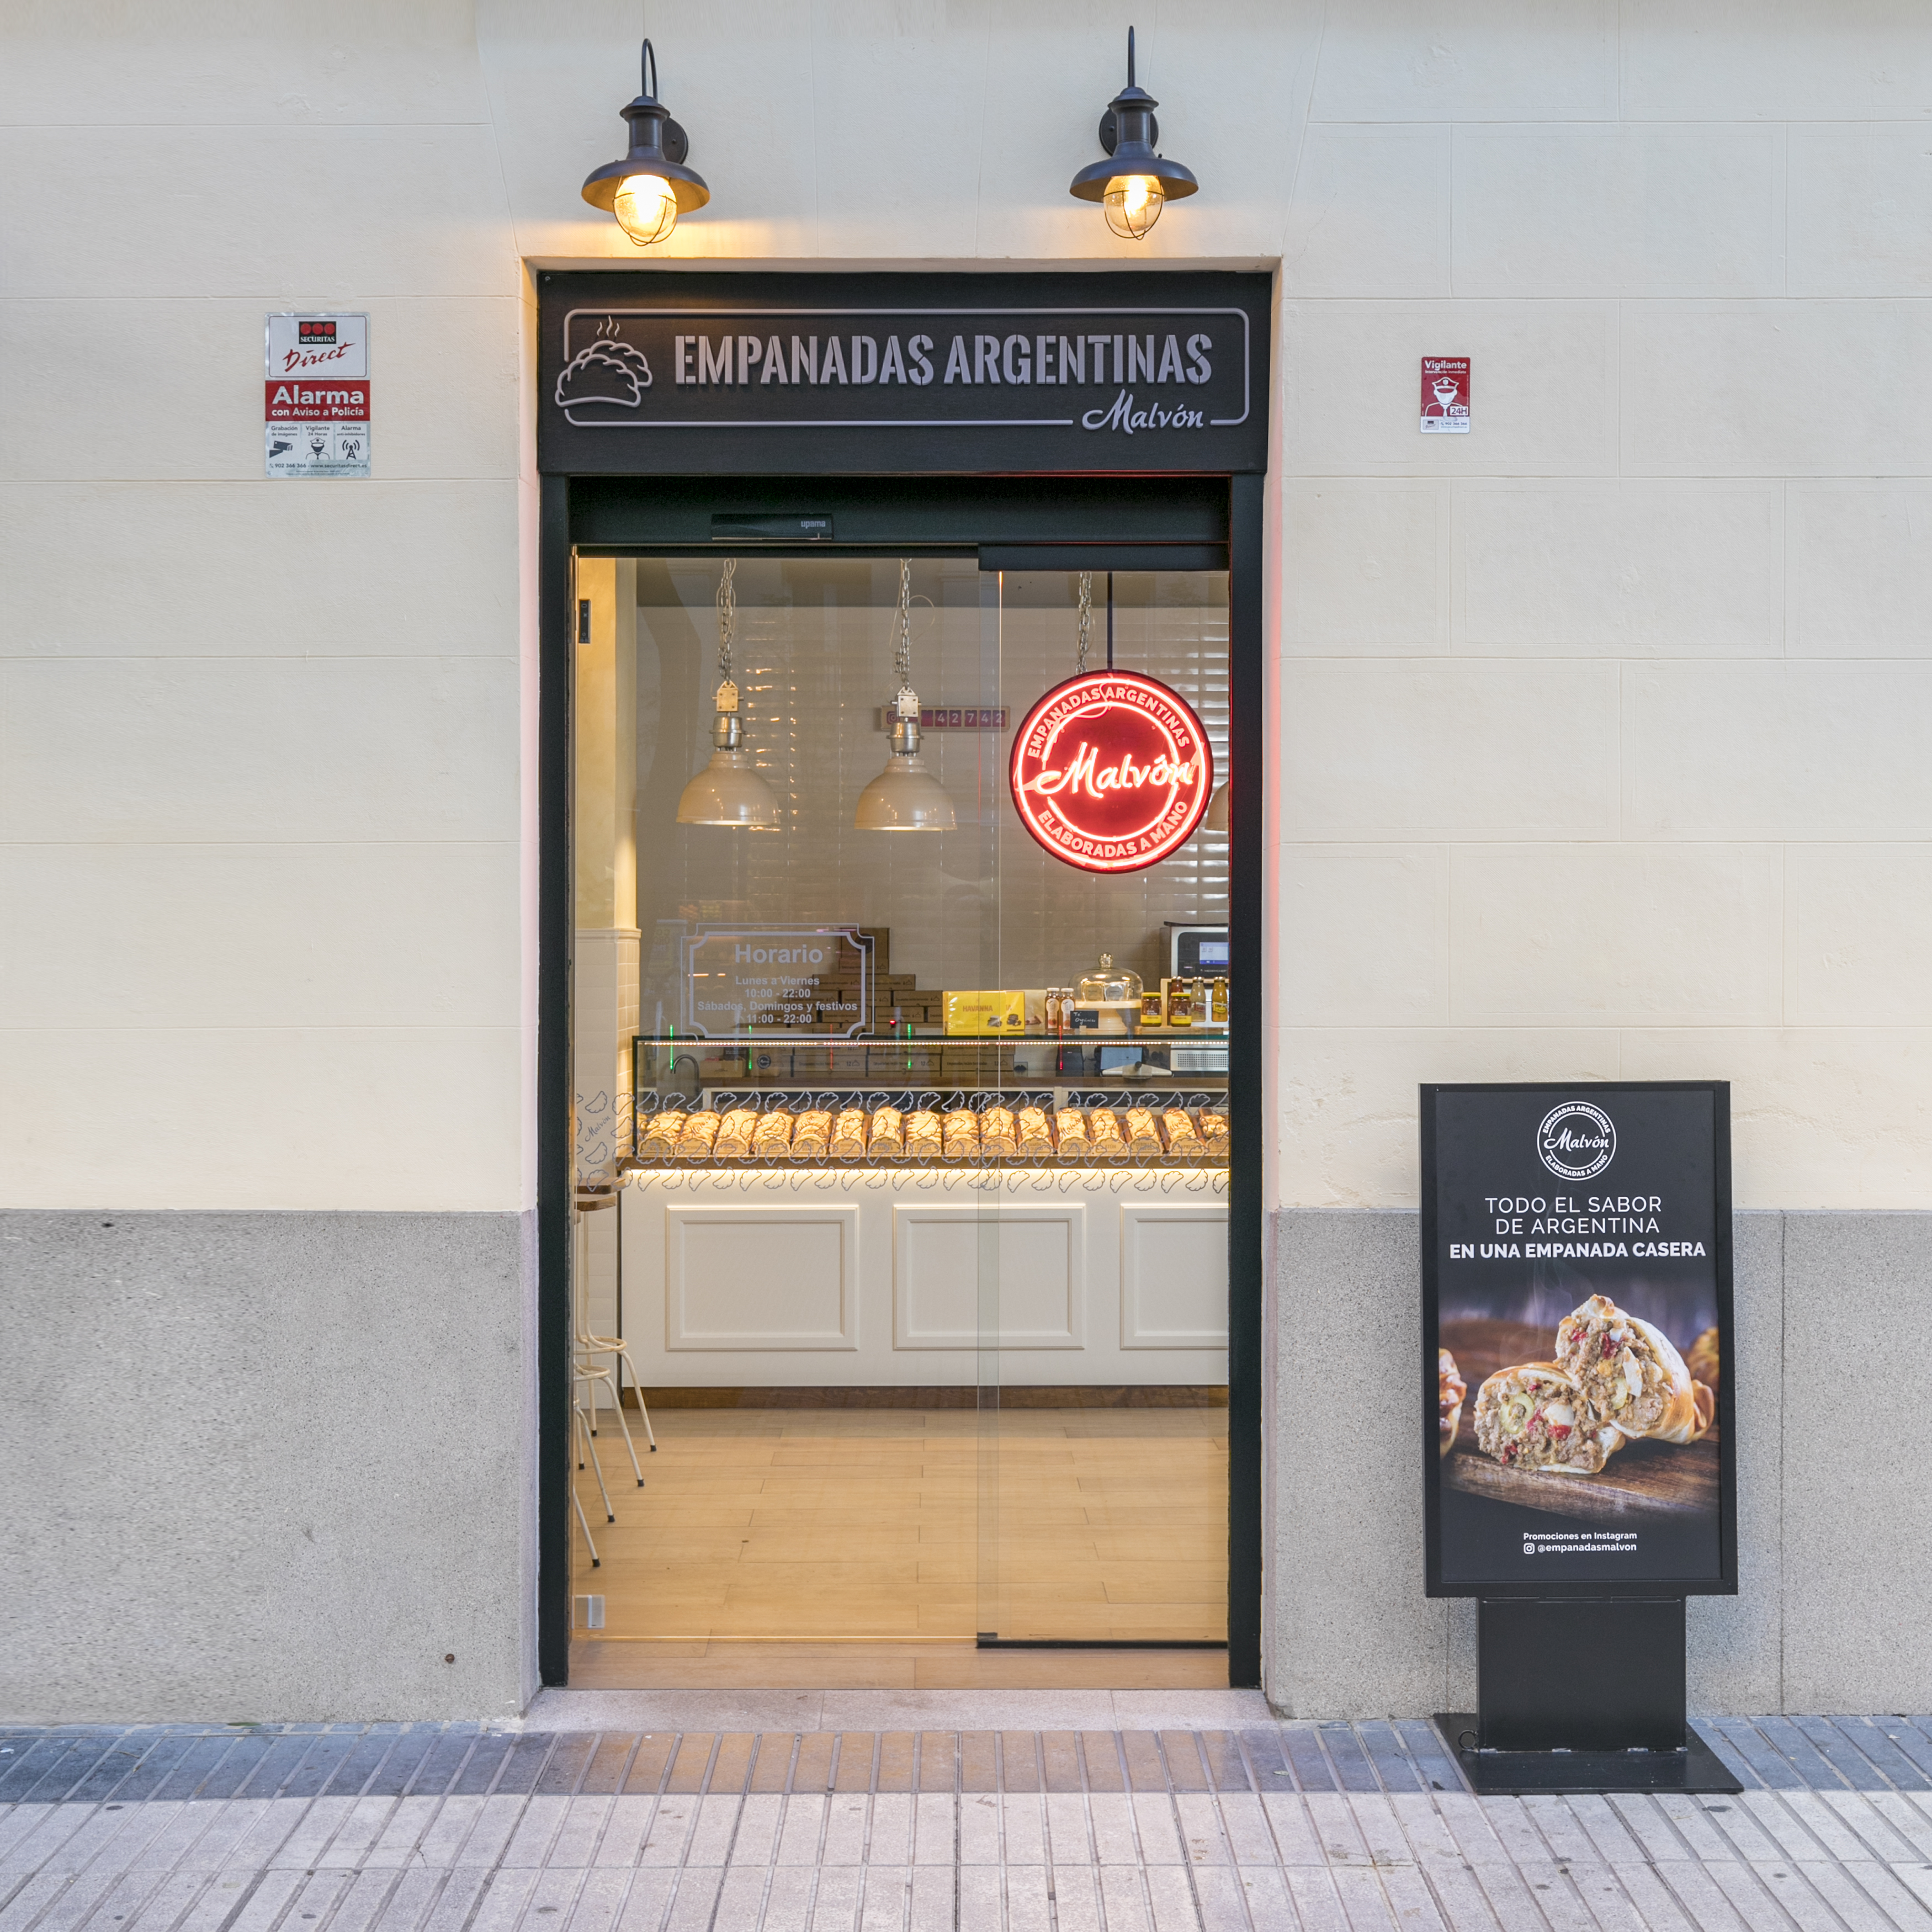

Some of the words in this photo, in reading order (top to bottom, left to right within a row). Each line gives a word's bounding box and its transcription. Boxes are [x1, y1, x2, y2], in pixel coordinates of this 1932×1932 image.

[283, 342, 356, 373] Direct
[674, 334, 935, 386] EMPANADAS
[943, 333, 1213, 386] ARGENTINAS
[1425, 360, 1467, 371] Vigilante
[272, 385, 364, 405] Alarma
[293, 407, 320, 416] Aviso
[331, 407, 364, 416] Policía
[1081, 388, 1204, 436] Malvón
[1028, 688, 1101, 758] EMPANADAS
[1105, 687, 1190, 748] ARGENTINAS
[1036, 741, 1193, 799] Malvón
[1038, 809, 1137, 857] ELABORADAS
[1140, 837, 1152, 851] A
[1150, 801, 1188, 844] MANO
[735, 944, 823, 964] Horario
[735, 976, 768, 985] Lunes
[780, 976, 820, 985] Viernes
[745, 989, 772, 998] 10:00
[782, 989, 811, 998] 22:00
[697, 1001, 746, 1012] Sábados,
[750, 1001, 804, 1013] Domingos
[806, 1004, 813, 1013] y
[816, 1001, 858, 1011] festivos
[746, 1014, 773, 1023] 11:00
[783, 1014, 812, 1023] 22:00
[585, 1114, 611, 1142] Malvón
[1542, 1105, 1576, 1134] EMPANADAS
[1576, 1105, 1611, 1134] ARGENTINAS
[1543, 1127, 1610, 1151] Malvón
[1545, 1154, 1586, 1177] ELABORADAS
[1591, 1154, 1609, 1172] MANO
[1485, 1197, 1546, 1214] TODO
[1555, 1197, 1580, 1213] EL
[1588, 1196, 1662, 1212] SABOR
[1496, 1218, 1523, 1235] DE
[1531, 1217, 1660, 1234] ARGENTINA
[1450, 1244, 1474, 1259] EN
[1480, 1243, 1521, 1259] UNA
[1525, 1242, 1628, 1258] EMPANADA
[1632, 1241, 1706, 1257] CASERA
[1594, 1532, 1637, 1541] Instagram
[1537, 1542, 1637, 1553] @empanadasmalvon
